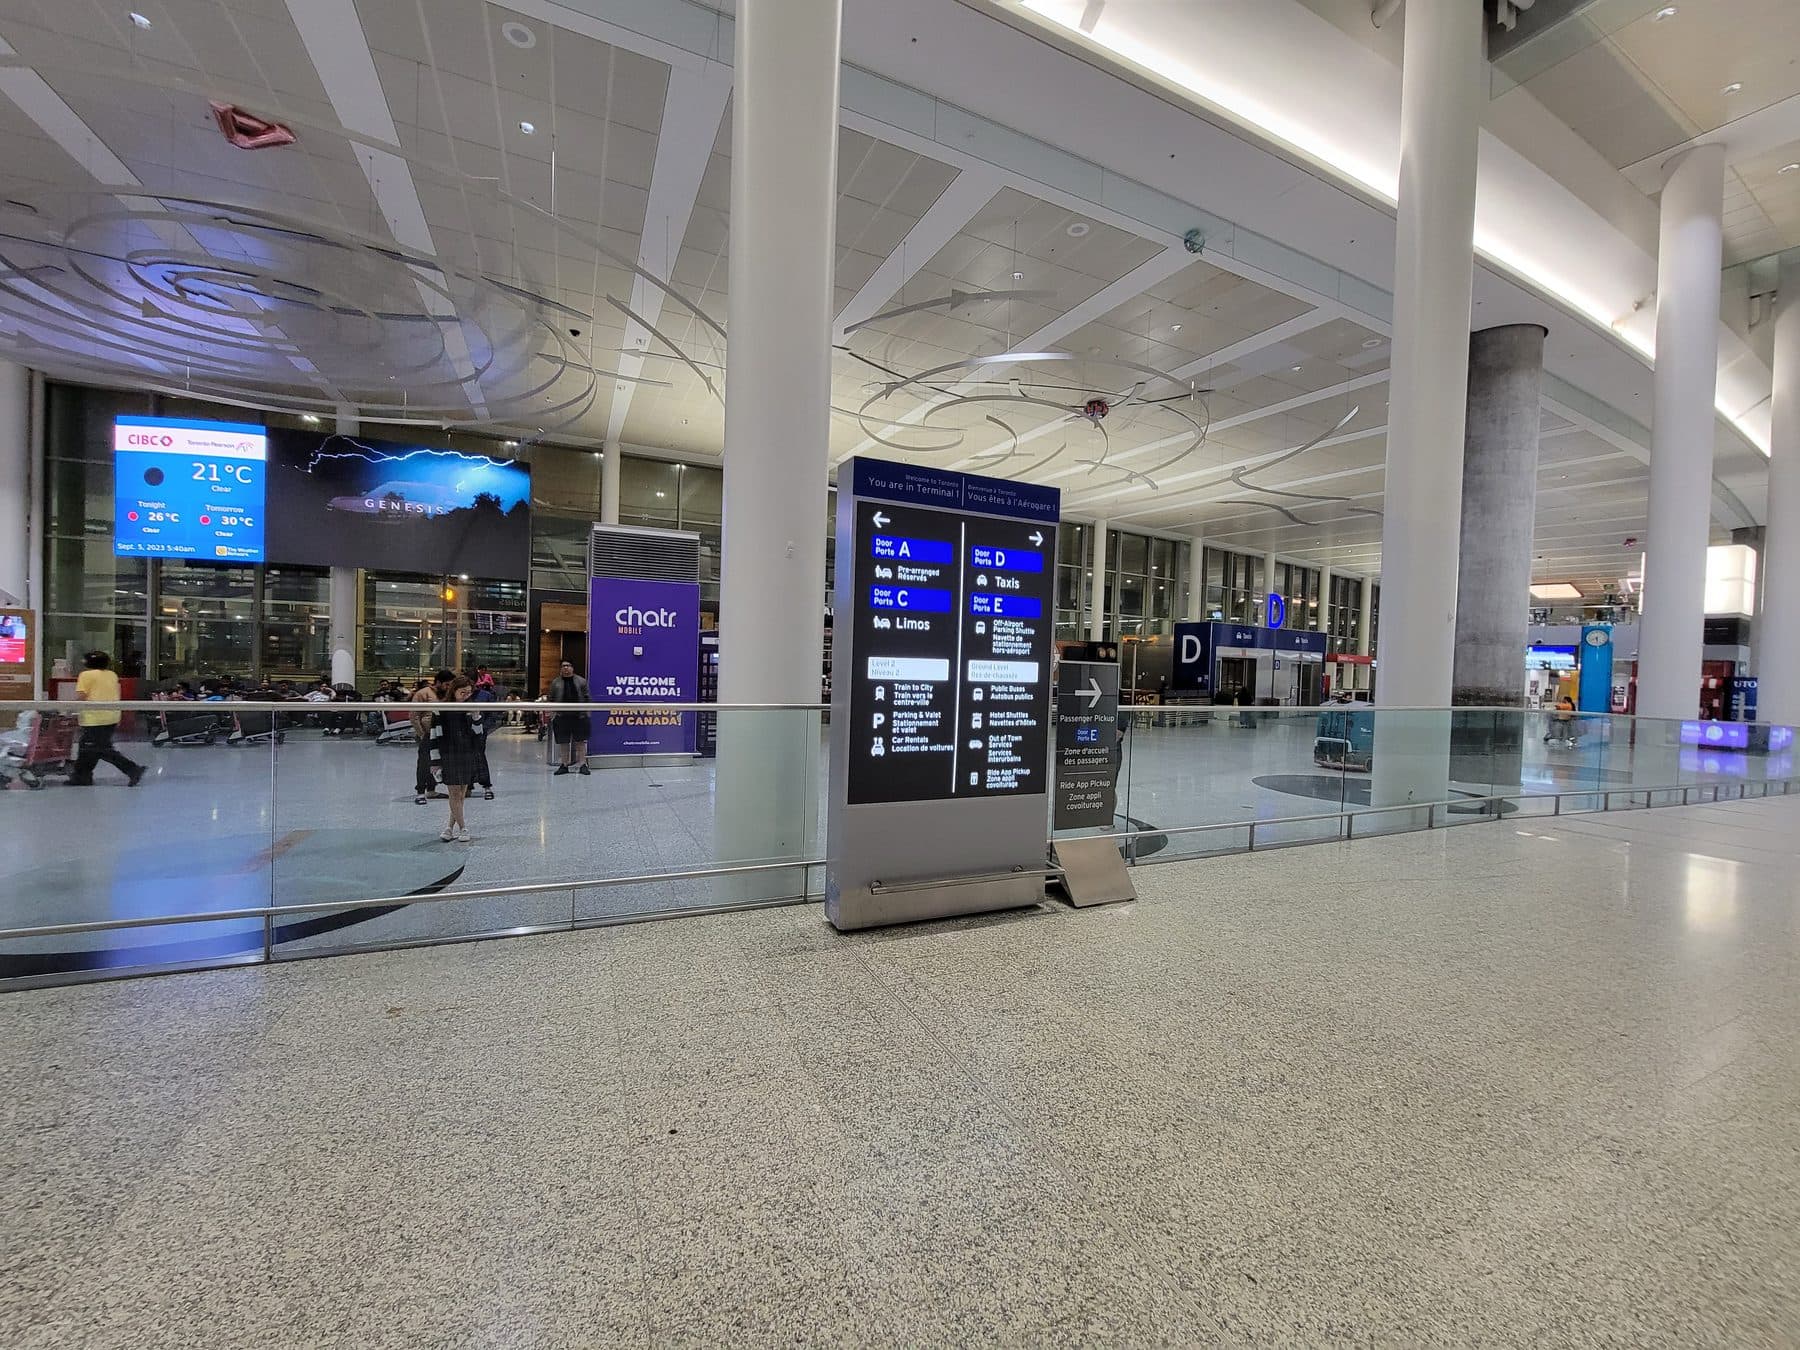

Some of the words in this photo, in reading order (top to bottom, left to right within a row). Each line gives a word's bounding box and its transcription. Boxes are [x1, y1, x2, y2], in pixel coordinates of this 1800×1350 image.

[128, 434, 158, 446] CIBC
[192, 462, 252, 484] 21°C
[906, 474, 929, 484] Welcome
[938, 479, 958, 488] Toronto
[868, 477, 886, 488] You
[888, 482, 904, 490] are
[906, 482, 914, 491] in
[917, 484, 952, 497] Terminal
[968, 484, 992, 493] Bienvenue
[968, 492, 988, 502] Vous
[990, 494, 1005, 505] êtes
[1006, 496, 1012, 506] à
[138, 500, 166, 510] Tonight
[205, 504, 244, 514] Tomorrow
[364, 498, 444, 514] GENESIS
[118, 543, 134, 551] Sept.
[876, 538, 893, 547] Door
[876, 547, 894, 556] Porte
[899, 541, 910, 557] A
[974, 549, 990, 558] Door
[974, 557, 992, 566] Porte
[995, 552, 1005, 566] D
[898, 566, 940, 576] Pre-arranged
[898, 573, 928, 582] Réservés
[995, 576, 1020, 589] Taxis
[874, 588, 891, 596] Door
[874, 597, 893, 606] Porte
[897, 590, 908, 606] C
[974, 596, 988, 604] Door
[974, 604, 990, 612] Porte
[994, 598, 1003, 613] E
[1268, 593, 1285, 629] D
[896, 617, 930, 630] Limos
[993, 620, 1024, 628] Off-Airport
[618, 626, 642, 634] MOBILE
[993, 626, 1014, 634] Parking
[1182, 635, 1201, 664] D
[616, 676, 676, 686] WELCOME
[606, 686, 622, 696] TO
[625, 687, 680, 696] CANADA!
[893, 712, 918, 720] Parking
[1060, 714, 1093, 724] Passenger
[1095, 714, 1114, 724] Pickup
[607, 717, 624, 726] AU
[1090, 730, 1098, 741] E
[1082, 746, 1109, 754] d'accueil
[1077, 756, 1108, 766] passagers
[1001, 769, 1012, 777] App
[1013, 768, 1030, 776] Pickup
[1060, 782, 1074, 790] Ride
[1076, 782, 1088, 790] App
[1090, 780, 1110, 788] Pickup
[1086, 792, 1102, 801] appli
[1066, 802, 1104, 810] covoiturage
